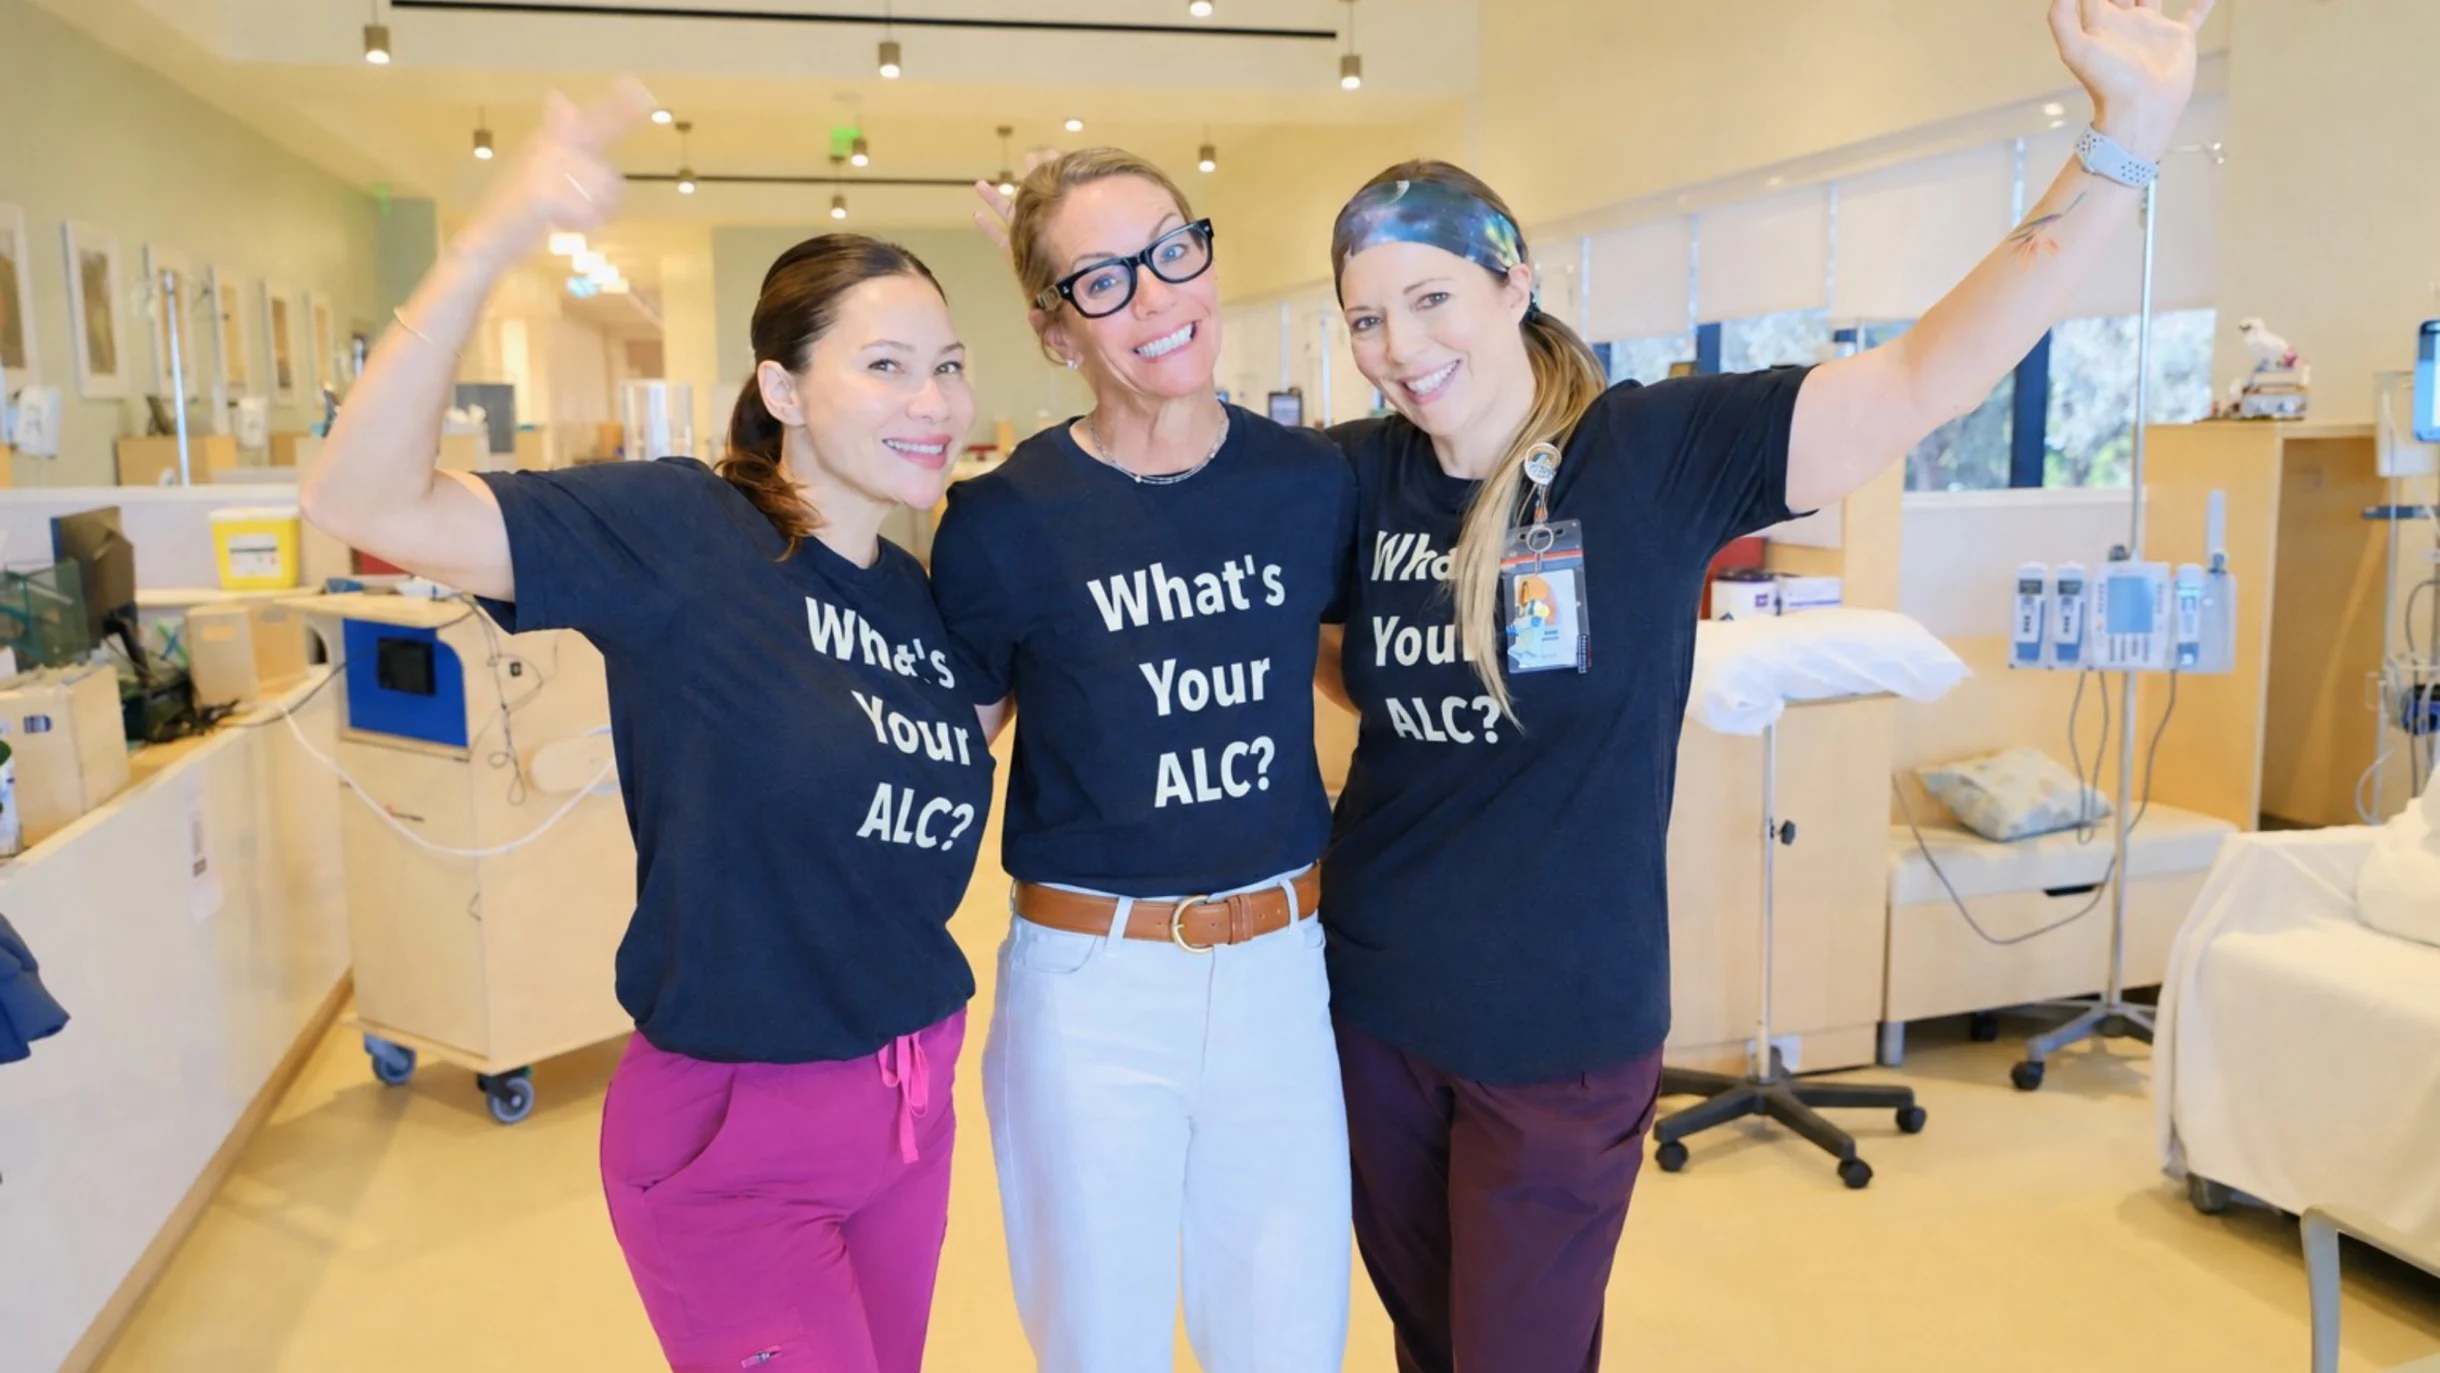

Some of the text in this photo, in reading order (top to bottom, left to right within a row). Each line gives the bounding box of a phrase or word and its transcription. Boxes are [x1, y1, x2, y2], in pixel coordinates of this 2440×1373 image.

[1371, 530, 1458, 581] Wha
[1087, 554, 1285, 632] What's
[1138, 657, 1270, 716] Your
[1385, 696, 1500, 744] ALC?
[851, 690, 971, 765] Your
[1154, 736, 1275, 808] ALC?
[856, 783, 974, 851] ALC?
